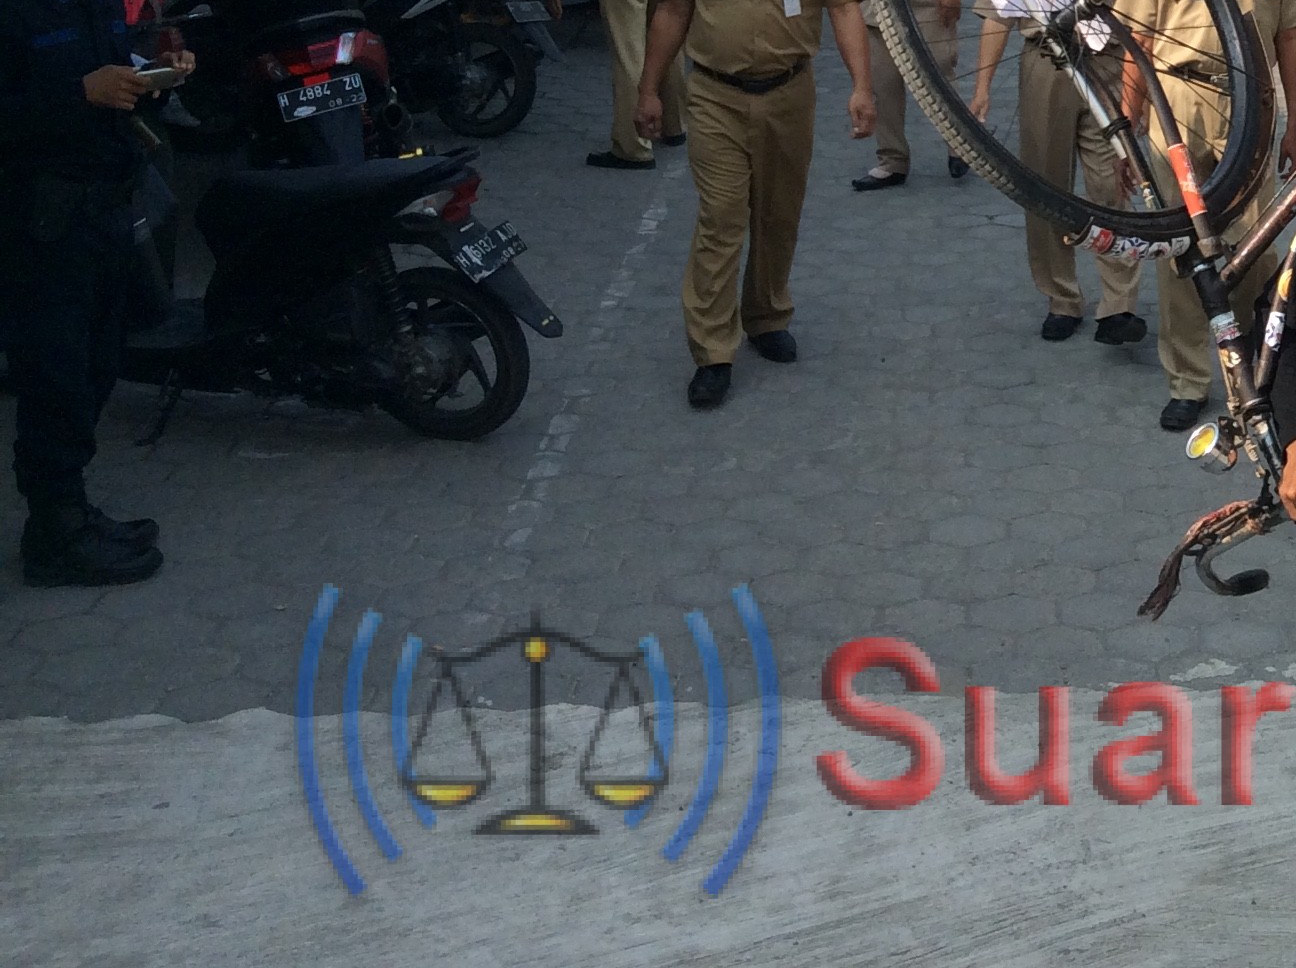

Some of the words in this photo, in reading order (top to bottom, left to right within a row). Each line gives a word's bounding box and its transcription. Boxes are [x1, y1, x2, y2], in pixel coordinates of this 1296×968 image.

[279, 94, 289, 107] H
[299, 83, 331, 101] 4884
[343, 76, 360, 91] ZU
